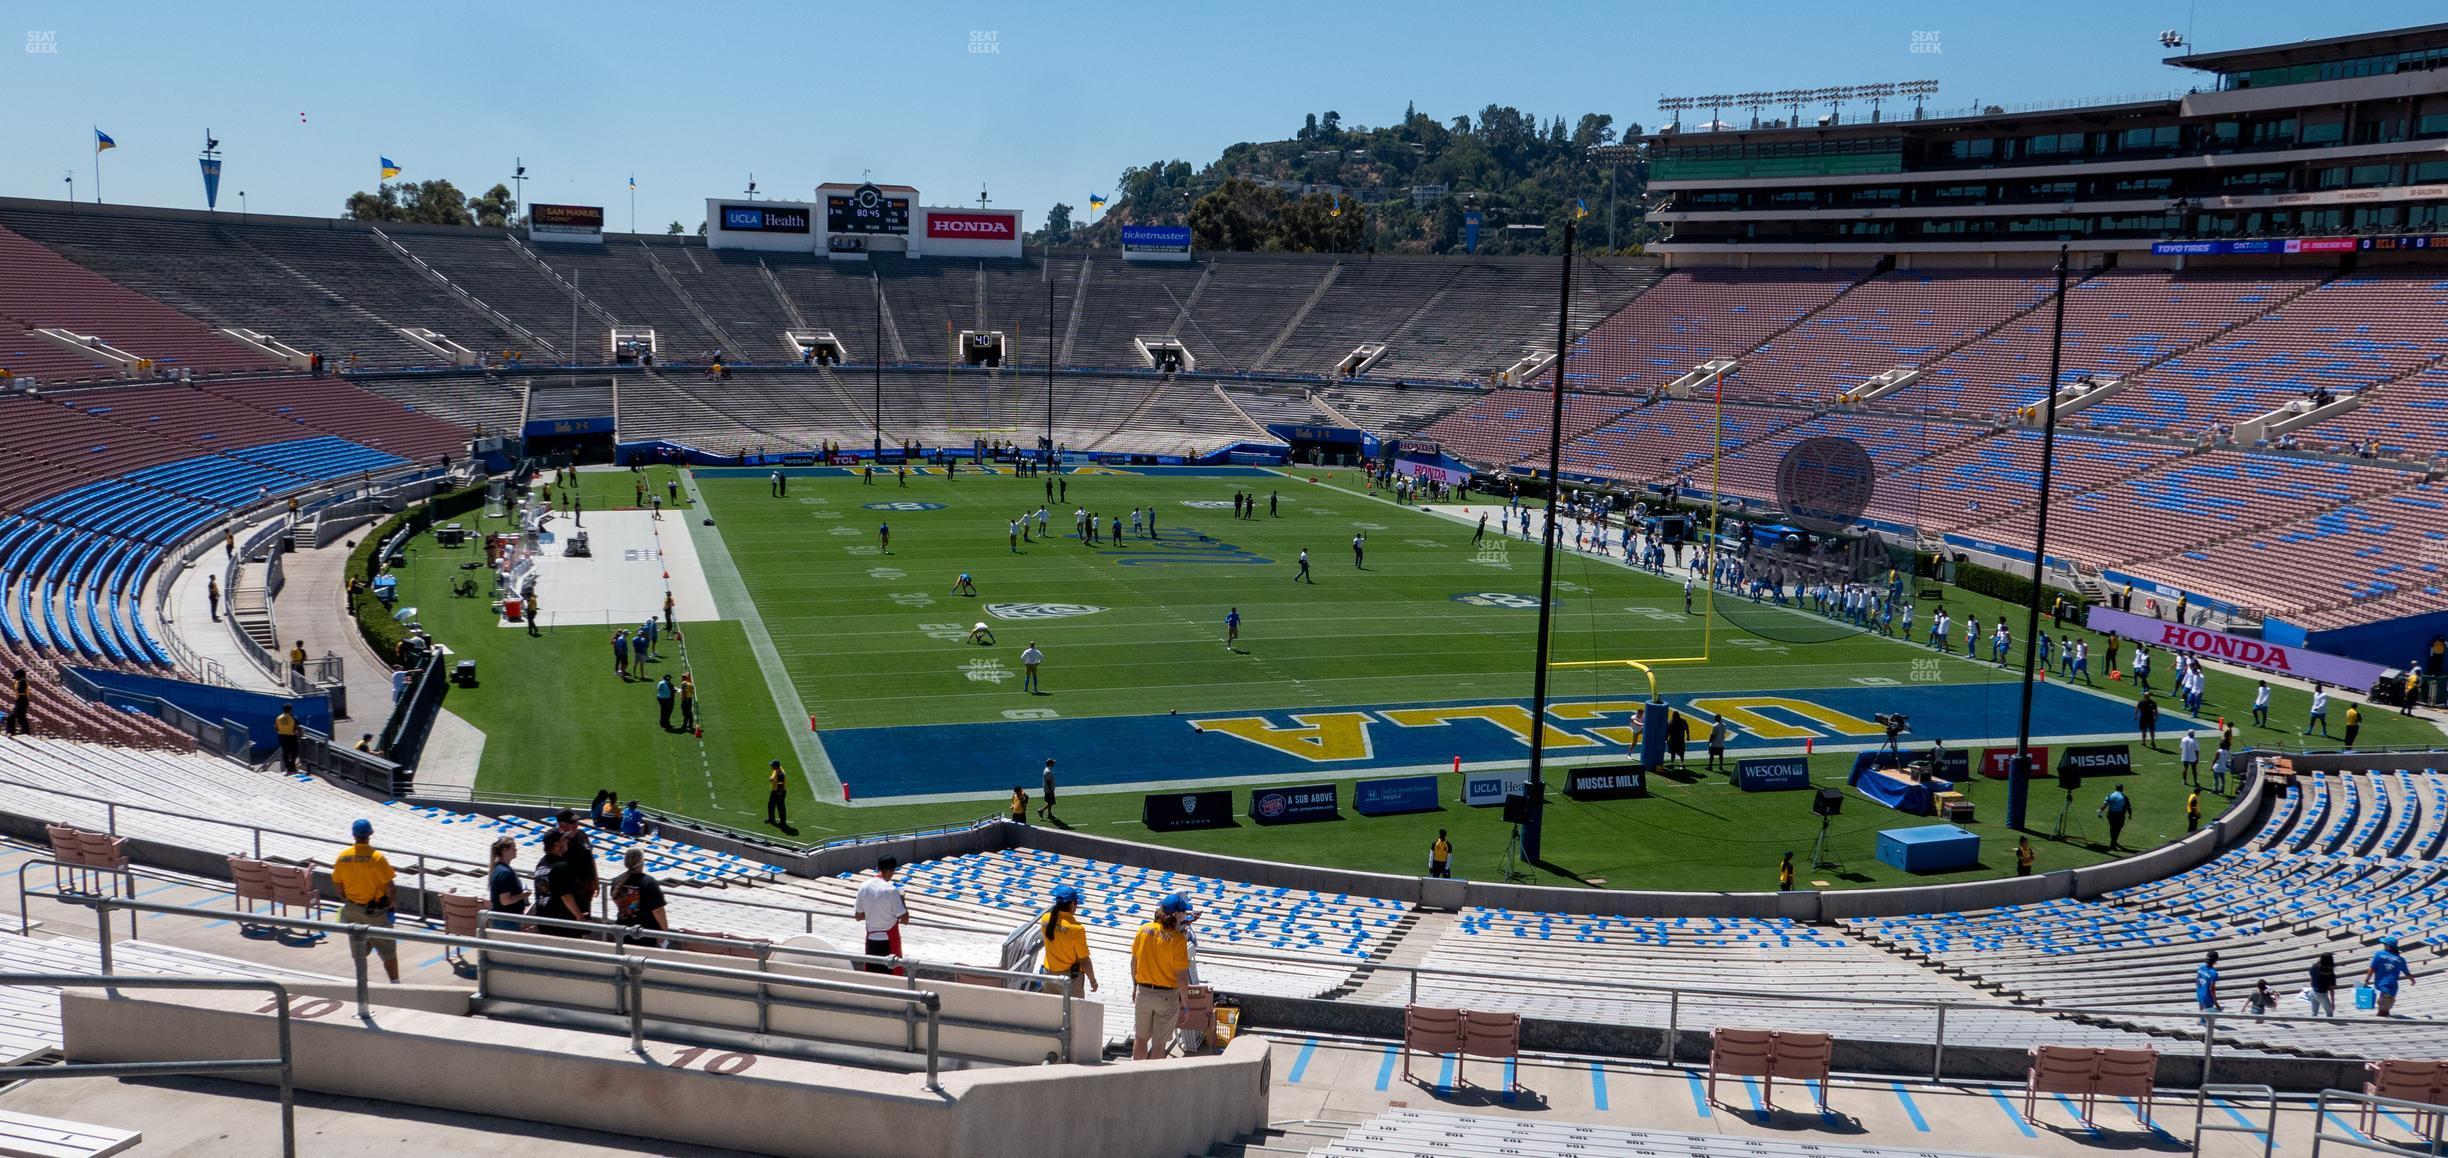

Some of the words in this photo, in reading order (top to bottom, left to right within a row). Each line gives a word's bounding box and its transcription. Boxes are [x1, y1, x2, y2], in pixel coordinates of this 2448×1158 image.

[546, 207, 565, 216] SAN
[566, 209, 602, 218] MANUEL
[730, 213, 758, 224] UCLA
[765, 214, 805, 227] Health
[934, 220, 1009, 233] HONDA
[1123, 231, 1185, 240] ticketmaster
[2158, 245, 2185, 253] TOYO
[2184, 244, 2210, 252] TIRES
[976, 335, 989, 346] 40
[1400, 442, 1435, 452] HONDA
[1414, 464, 1447, 481] HONDA
[2160, 624, 2292, 671] HONDA
[1993, 753, 2040, 771] TL
[2070, 753, 2129, 767] NISSAN
[1745, 764, 1791, 777] WESCOM
[1474, 783, 1498, 793] UCLA
[1576, 776, 1614, 790] MUSCLE
[1615, 774, 1639, 787] MILK
[1288, 795, 1293, 804] A
[1294, 793, 1309, 804] SUB
[1311, 792, 1333, 803] ABOVE
[668, 1046, 757, 1076] 10
